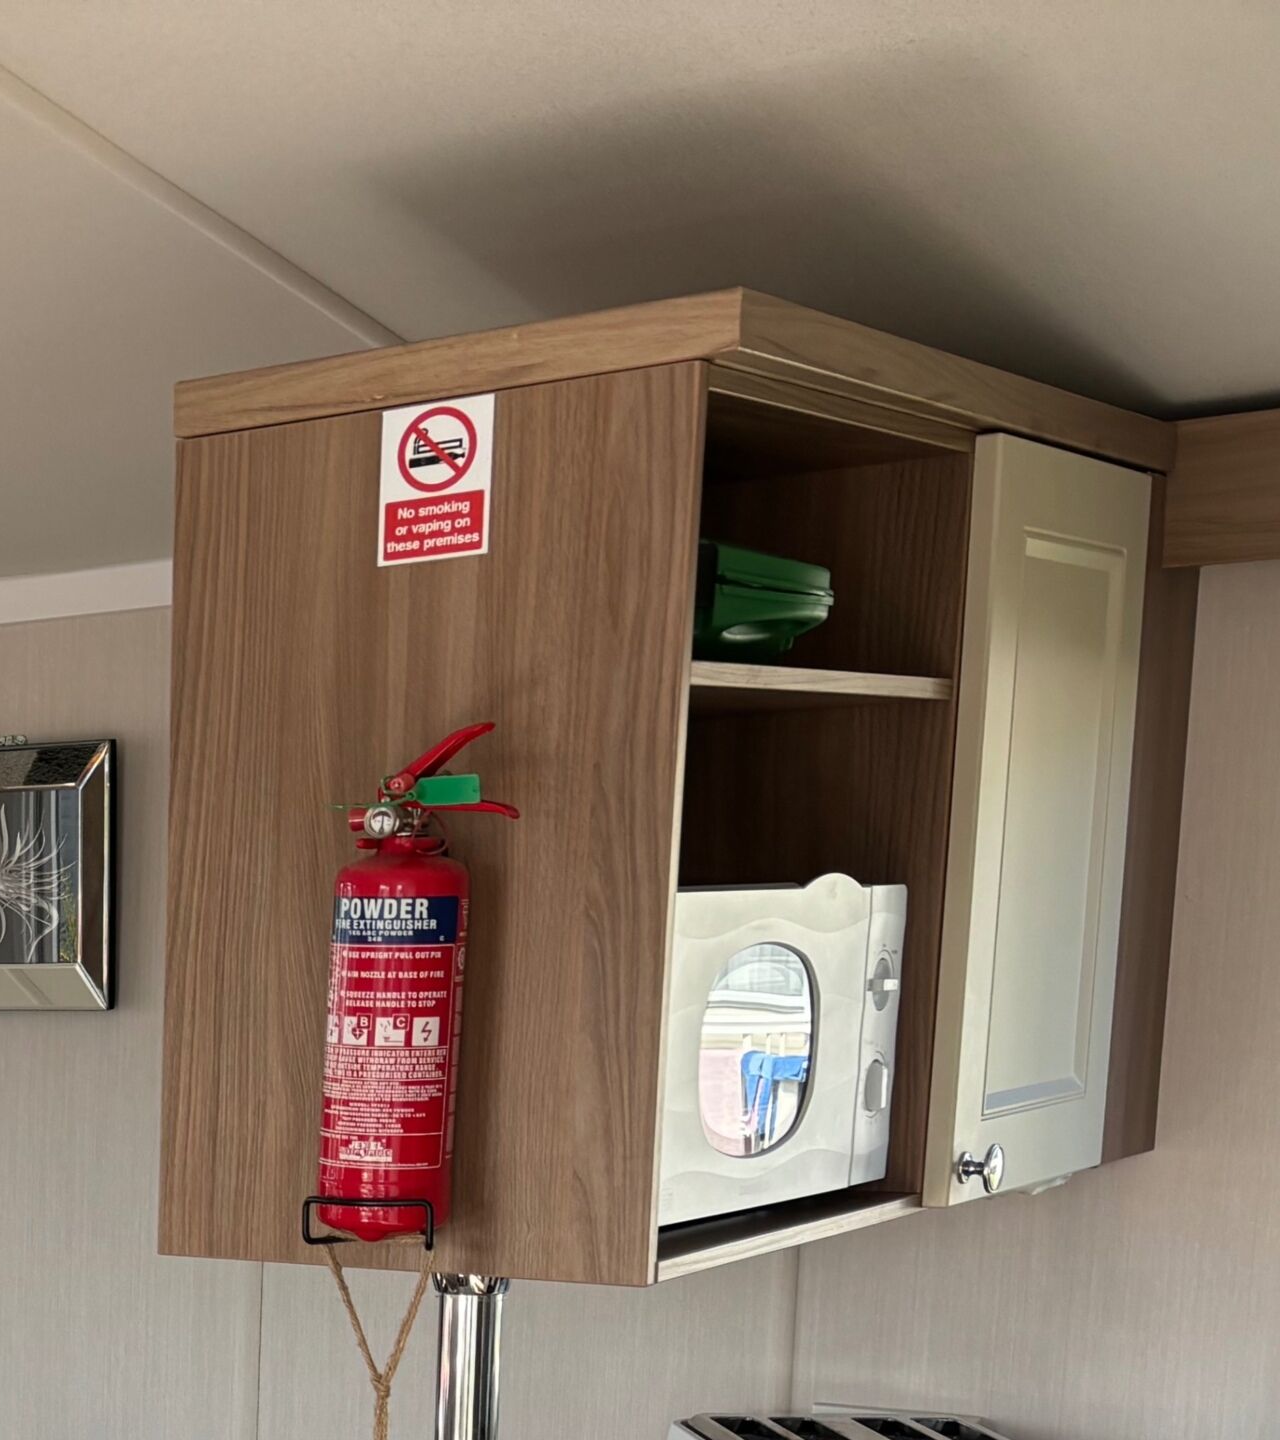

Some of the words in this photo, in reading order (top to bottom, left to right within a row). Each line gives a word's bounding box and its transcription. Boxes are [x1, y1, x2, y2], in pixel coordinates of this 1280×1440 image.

[398, 507, 415, 519] No
[418, 500, 470, 516] smoking
[395, 525, 408, 536] or
[411, 518, 451, 535] vaping
[455, 516, 471, 528] on
[387, 541, 420, 553] these
[423, 532, 480, 550] premises
[341, 898, 429, 919] POWDER
[353, 919, 437, 930] EXTINGUISHER
[361, 951, 393, 959] UPRIGHT
[395, 951, 414, 959] PULL
[360, 971, 386, 979] NOZZLE
[387, 971, 397, 979] AT
[398, 971, 418, 979] BASE
[419, 971, 429, 979] OF
[376, 991, 406, 999] HANDLE
[408, 991, 418, 999] TO
[419, 990, 447, 999] OPERATE
[375, 1000, 406, 1008] HANDLE
[407, 1000, 417, 1008] TO
[418, 999, 436, 1007] STOP
[361, 1017, 368, 1026] B
[396, 1017, 406, 1027] C
